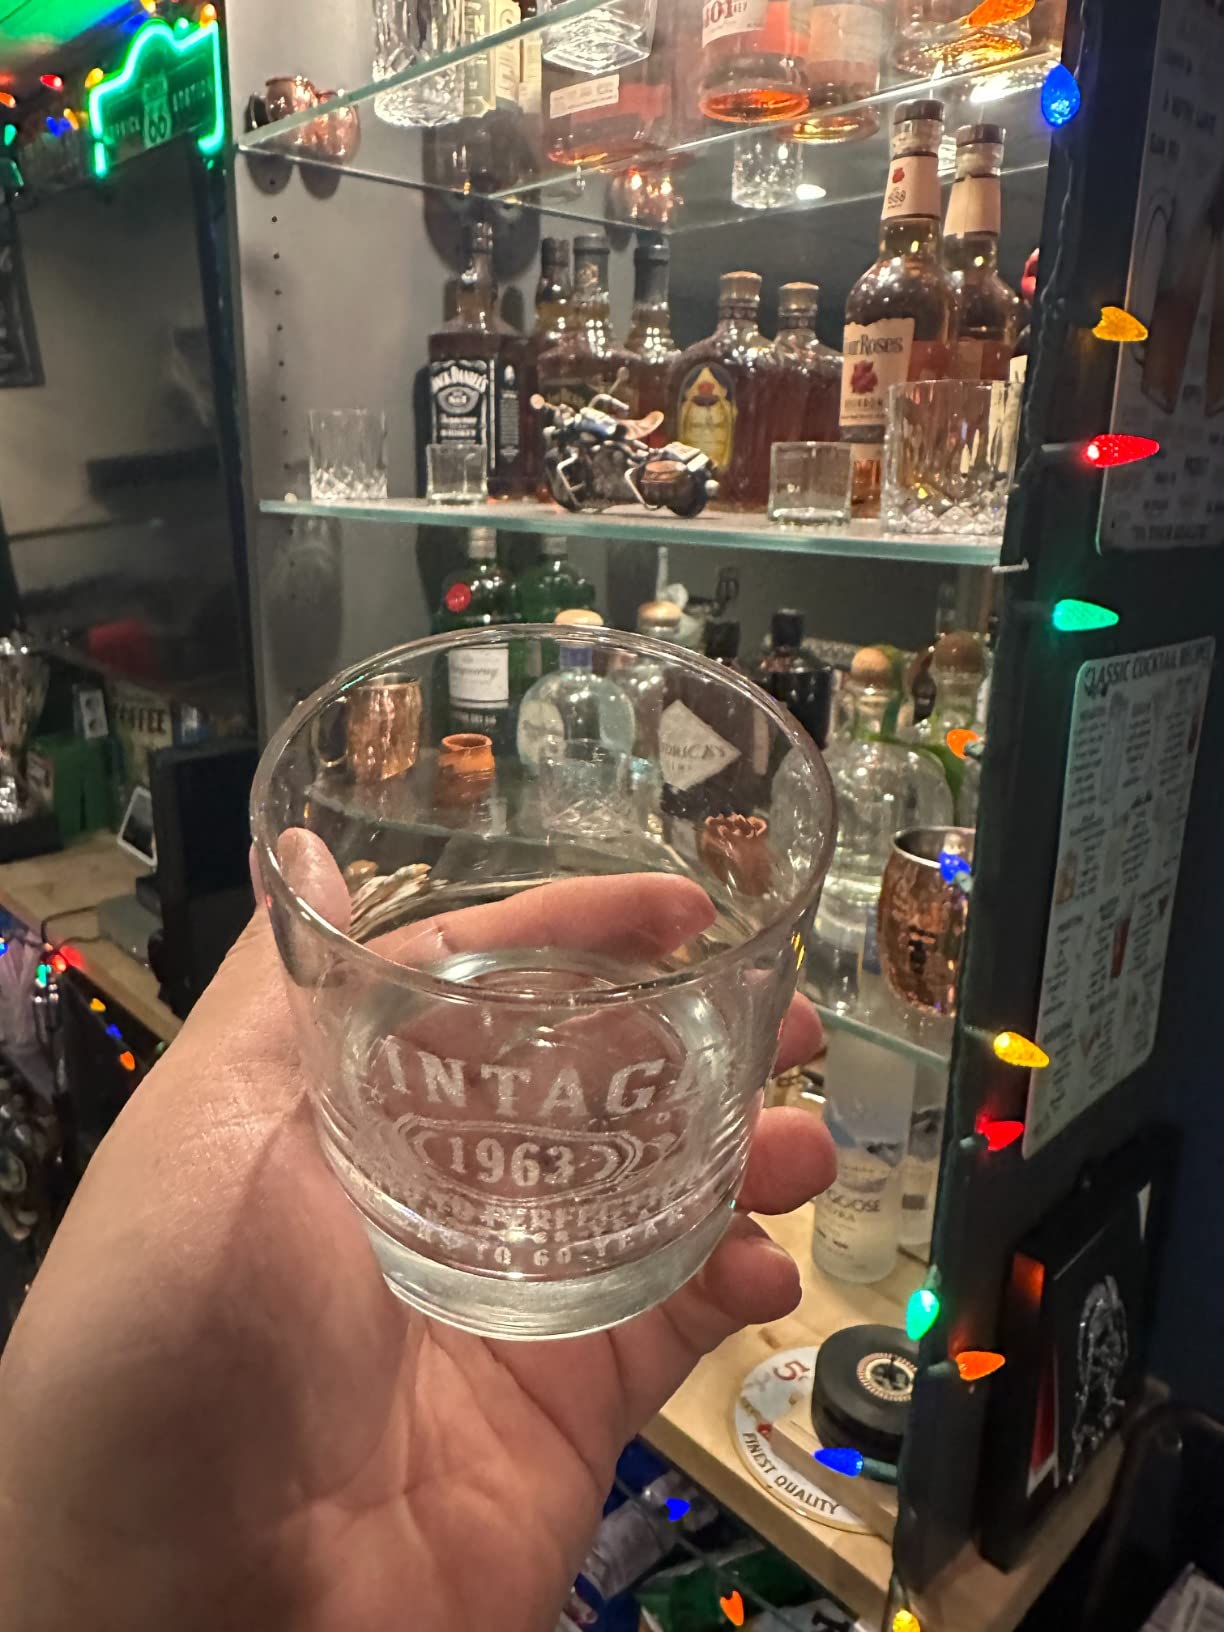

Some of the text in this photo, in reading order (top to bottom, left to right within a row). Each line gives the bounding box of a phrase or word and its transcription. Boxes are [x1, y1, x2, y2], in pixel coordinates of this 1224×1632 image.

[861, 333, 904, 356] Roses
[448, 1136, 575, 1187] 1963
[743, 1432, 841, 1516] FINEST QUALITY
